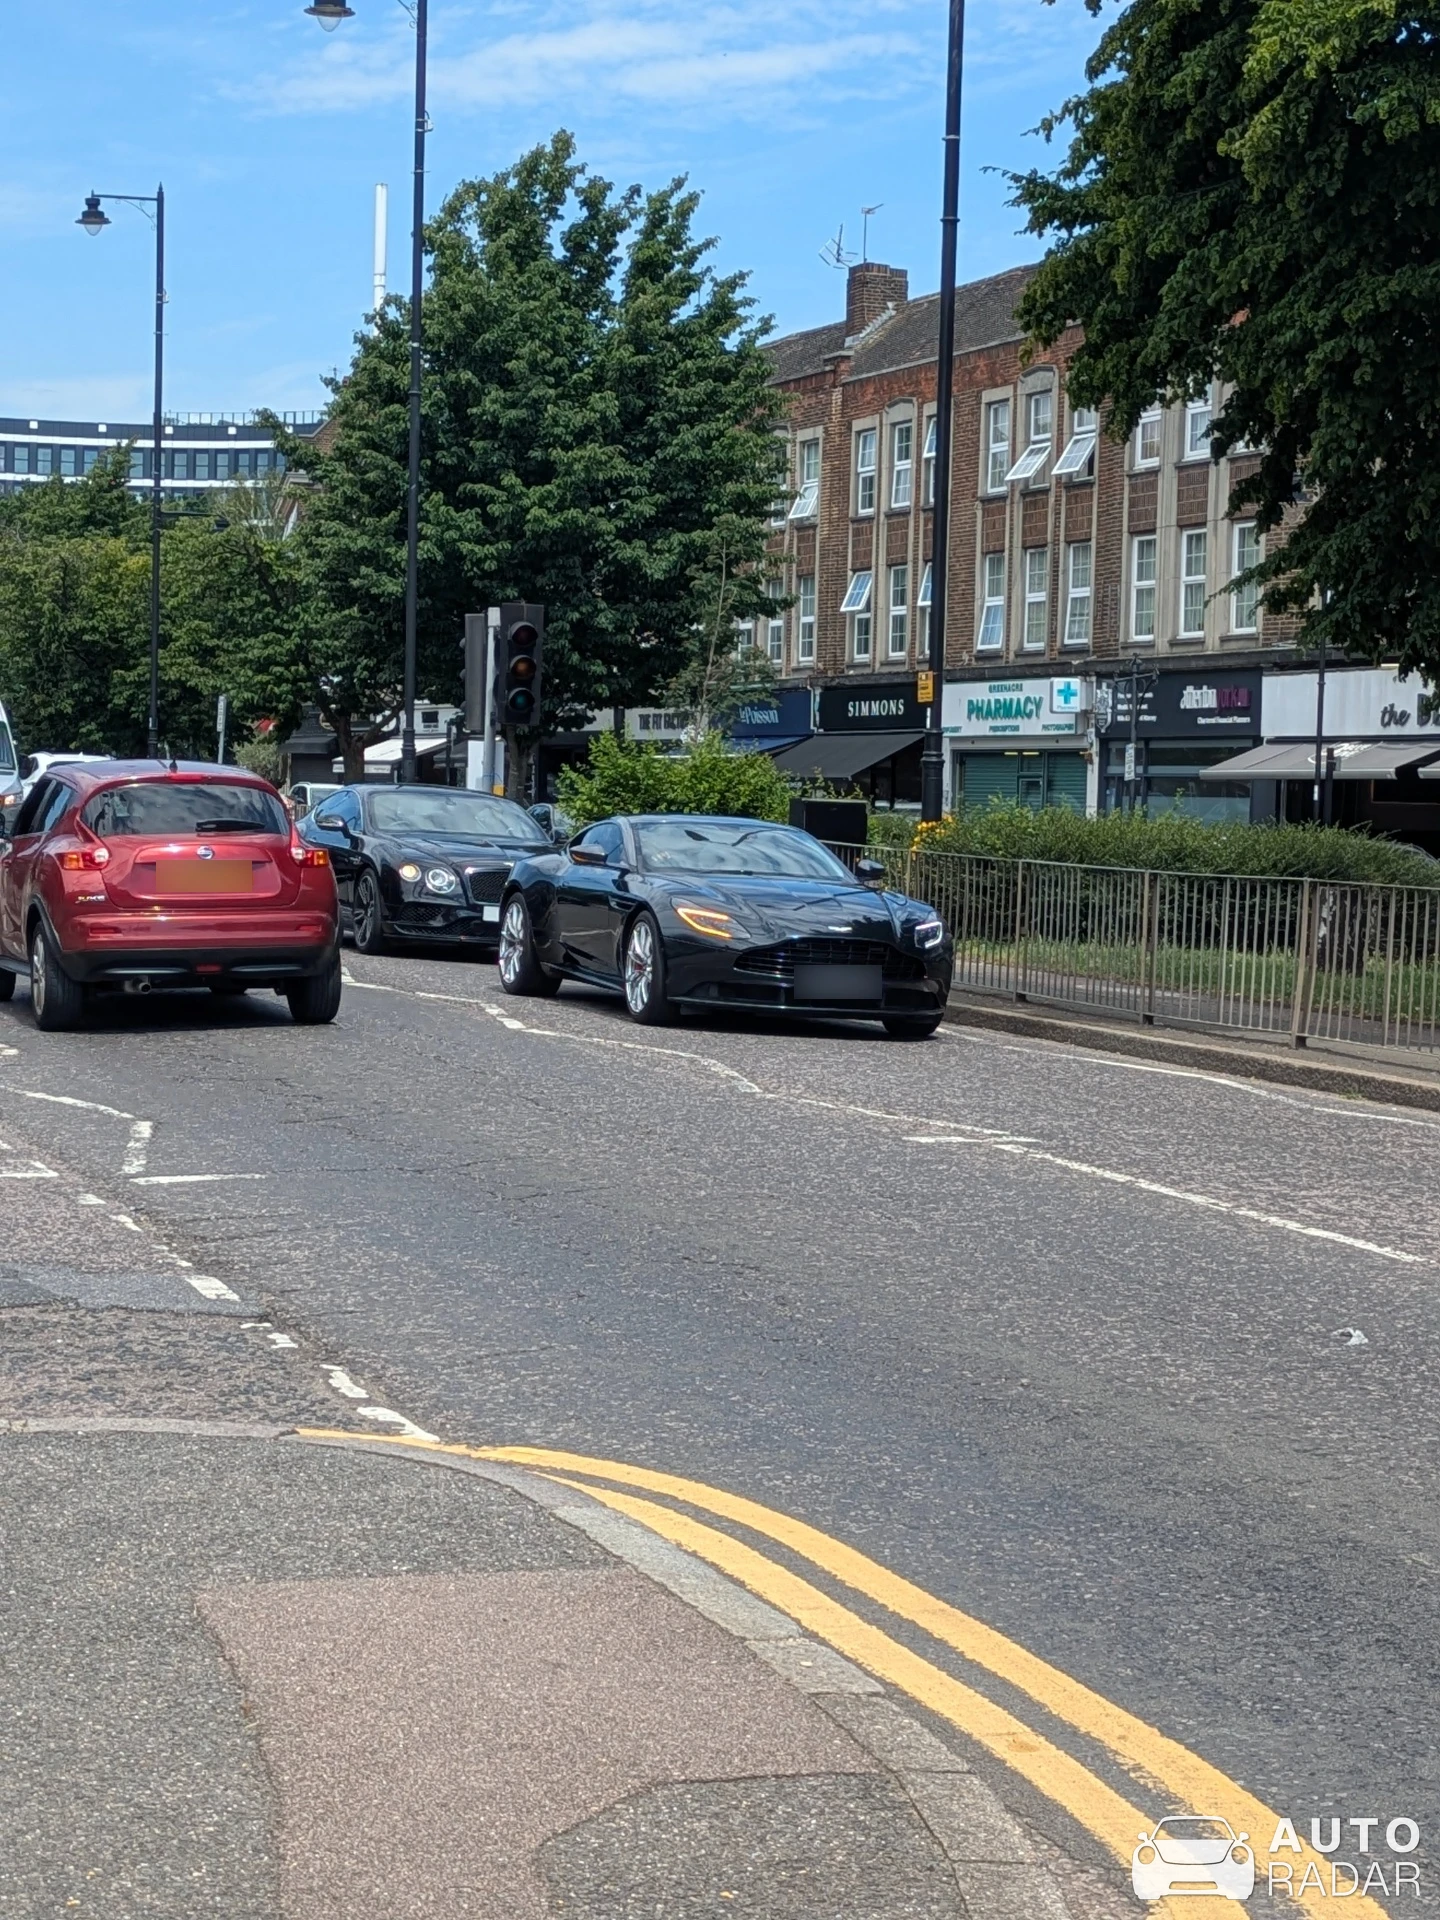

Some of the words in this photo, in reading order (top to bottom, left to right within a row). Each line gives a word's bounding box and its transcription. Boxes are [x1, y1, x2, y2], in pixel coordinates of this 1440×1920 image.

[745, 706, 779, 724] Poisson
[848, 699, 905, 717] SIMMONS
[967, 696, 1044, 721] PHARMACY
[1381, 703, 1411, 728] the
